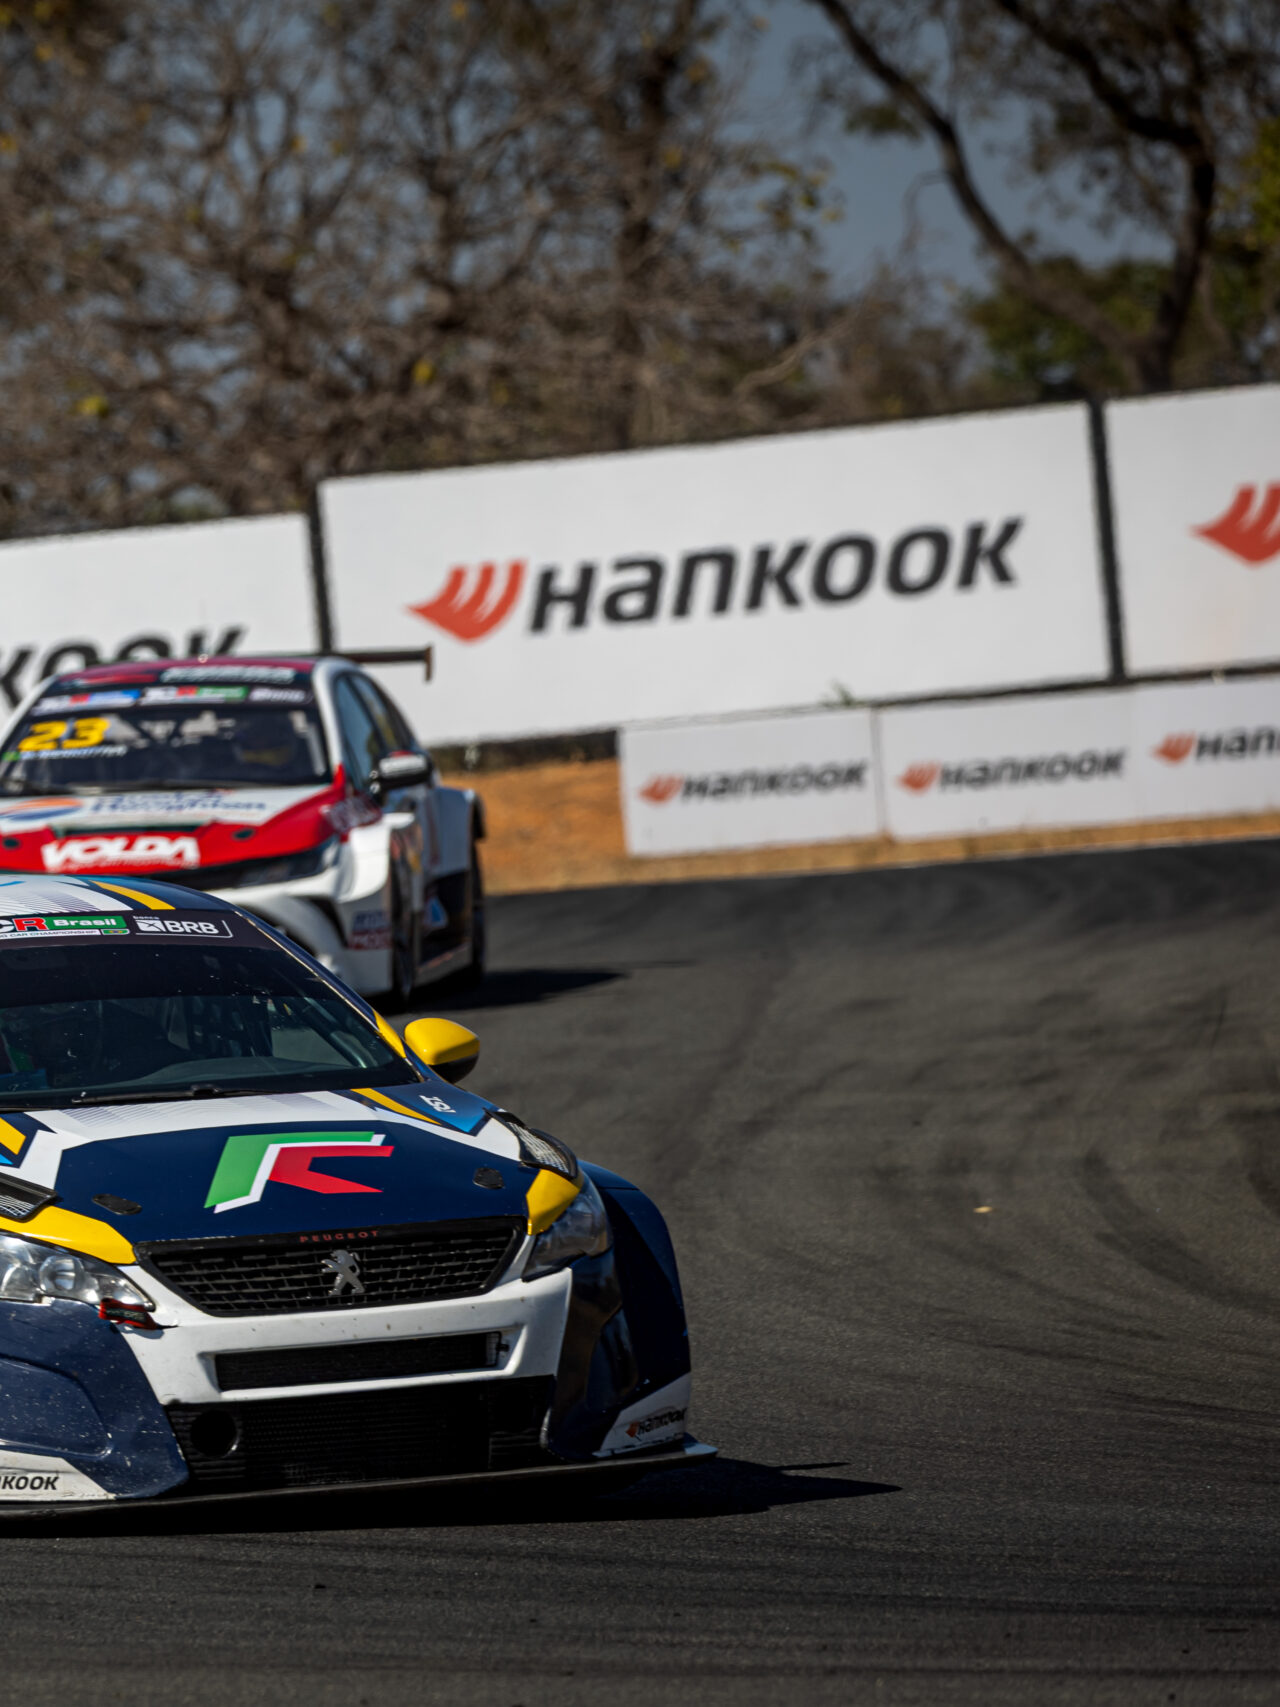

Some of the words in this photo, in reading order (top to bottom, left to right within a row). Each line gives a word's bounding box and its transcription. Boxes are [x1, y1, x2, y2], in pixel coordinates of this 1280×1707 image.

[19, 717, 110, 752] 23
[41, 835, 200, 873] VOLDA
[53, 918, 117, 927] Brasil
[163, 920, 219, 934] BRB
[299, 1230, 379, 1243] PEUGEOT
